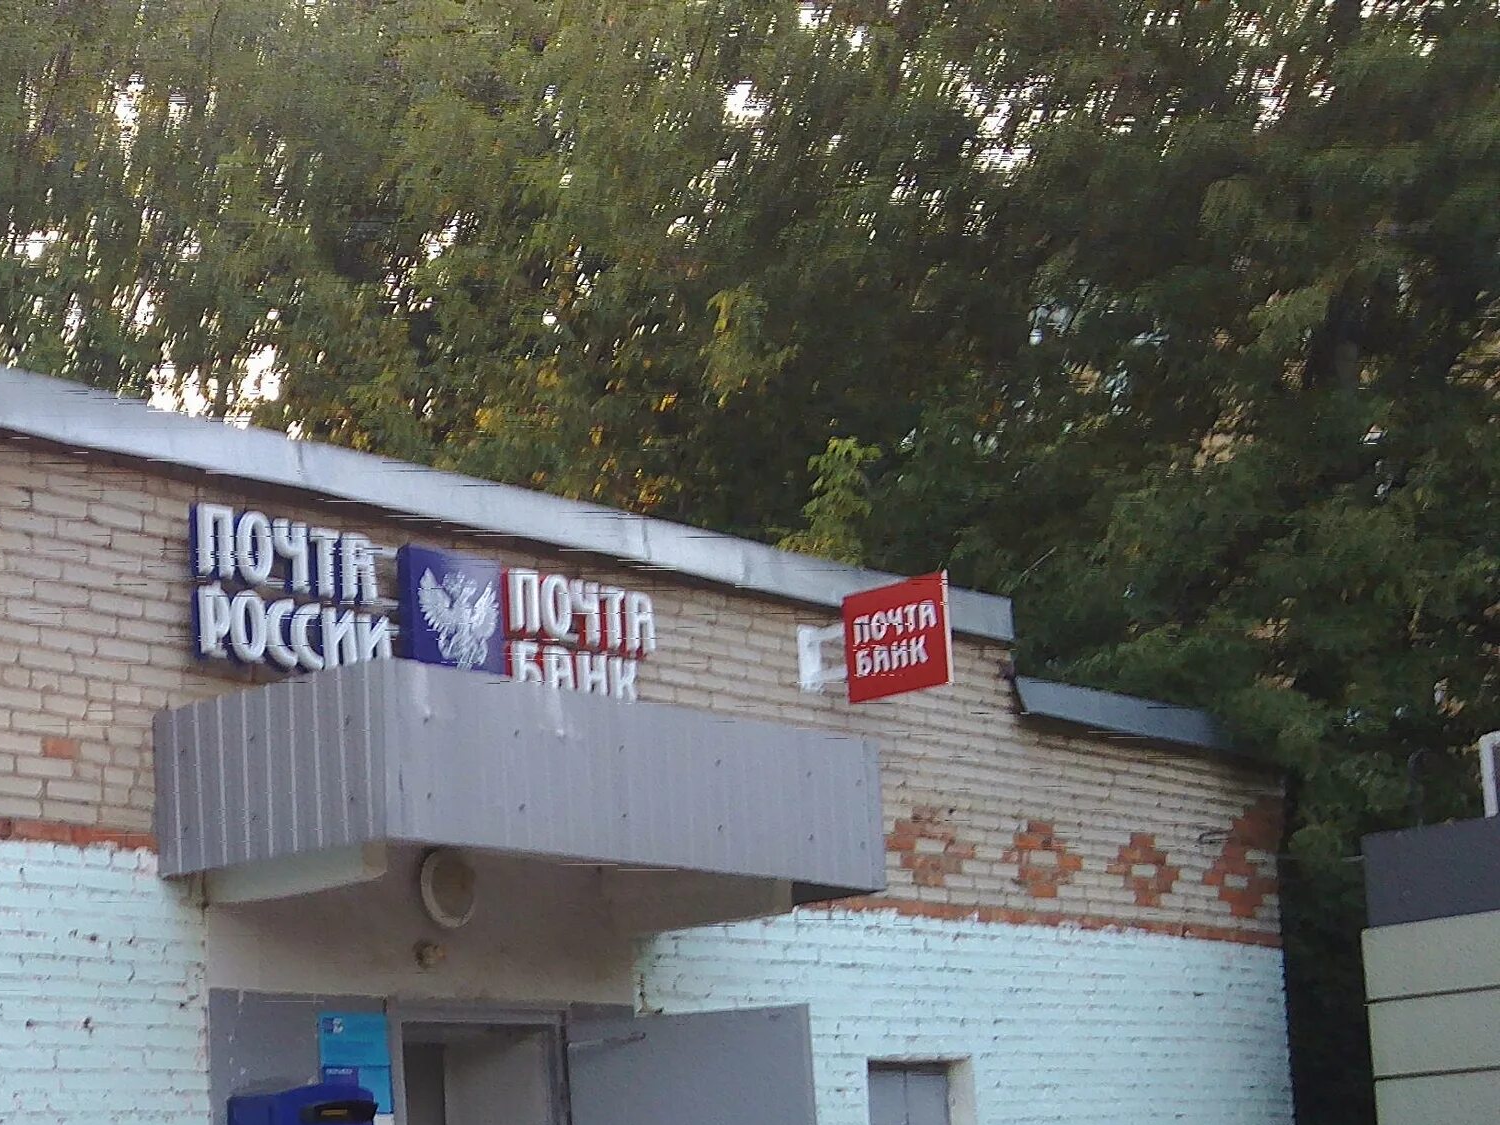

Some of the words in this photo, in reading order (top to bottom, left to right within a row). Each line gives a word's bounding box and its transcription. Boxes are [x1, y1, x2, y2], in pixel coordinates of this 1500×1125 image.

[195, 502, 379, 600] ПОЧТА
[195, 579, 393, 671] РОССИИ
[506, 567, 657, 653] ПОЧТА
[852, 599, 938, 645] ПОЧТА
[509, 640, 638, 701] БАНК
[855, 634, 929, 678] БАНК
